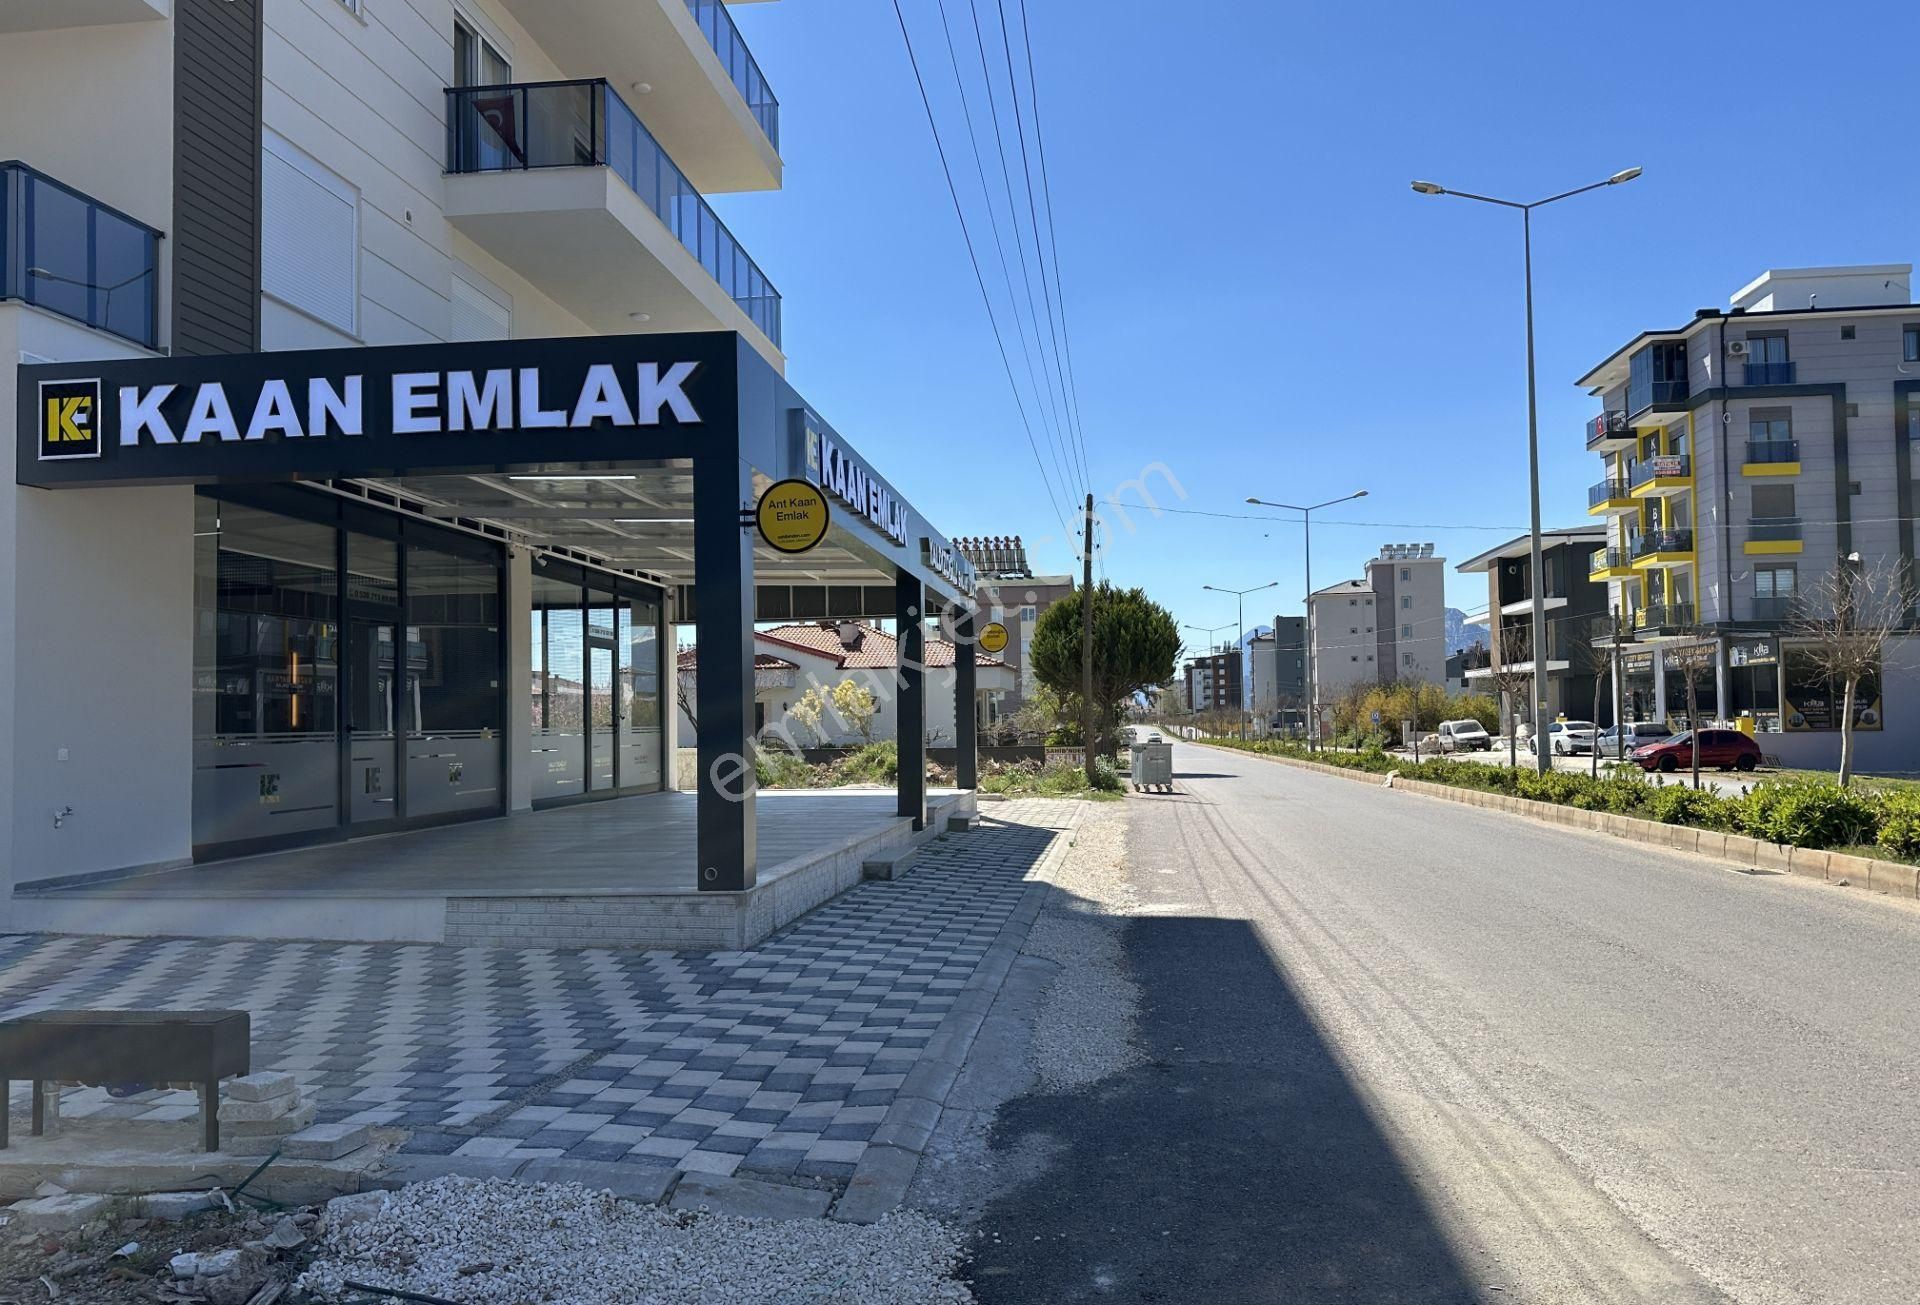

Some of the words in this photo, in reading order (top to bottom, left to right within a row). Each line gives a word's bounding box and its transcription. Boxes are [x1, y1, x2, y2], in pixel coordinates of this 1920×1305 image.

[119, 375, 363, 446] KAAN
[391, 360, 702, 434] EMLAK
[768, 499, 787, 509] Ant
[789, 497, 817, 507] Kaan
[820, 433, 867, 517] KAAN
[868, 477, 909, 547] EMLAK
[776, 510, 809, 521] Emlak
